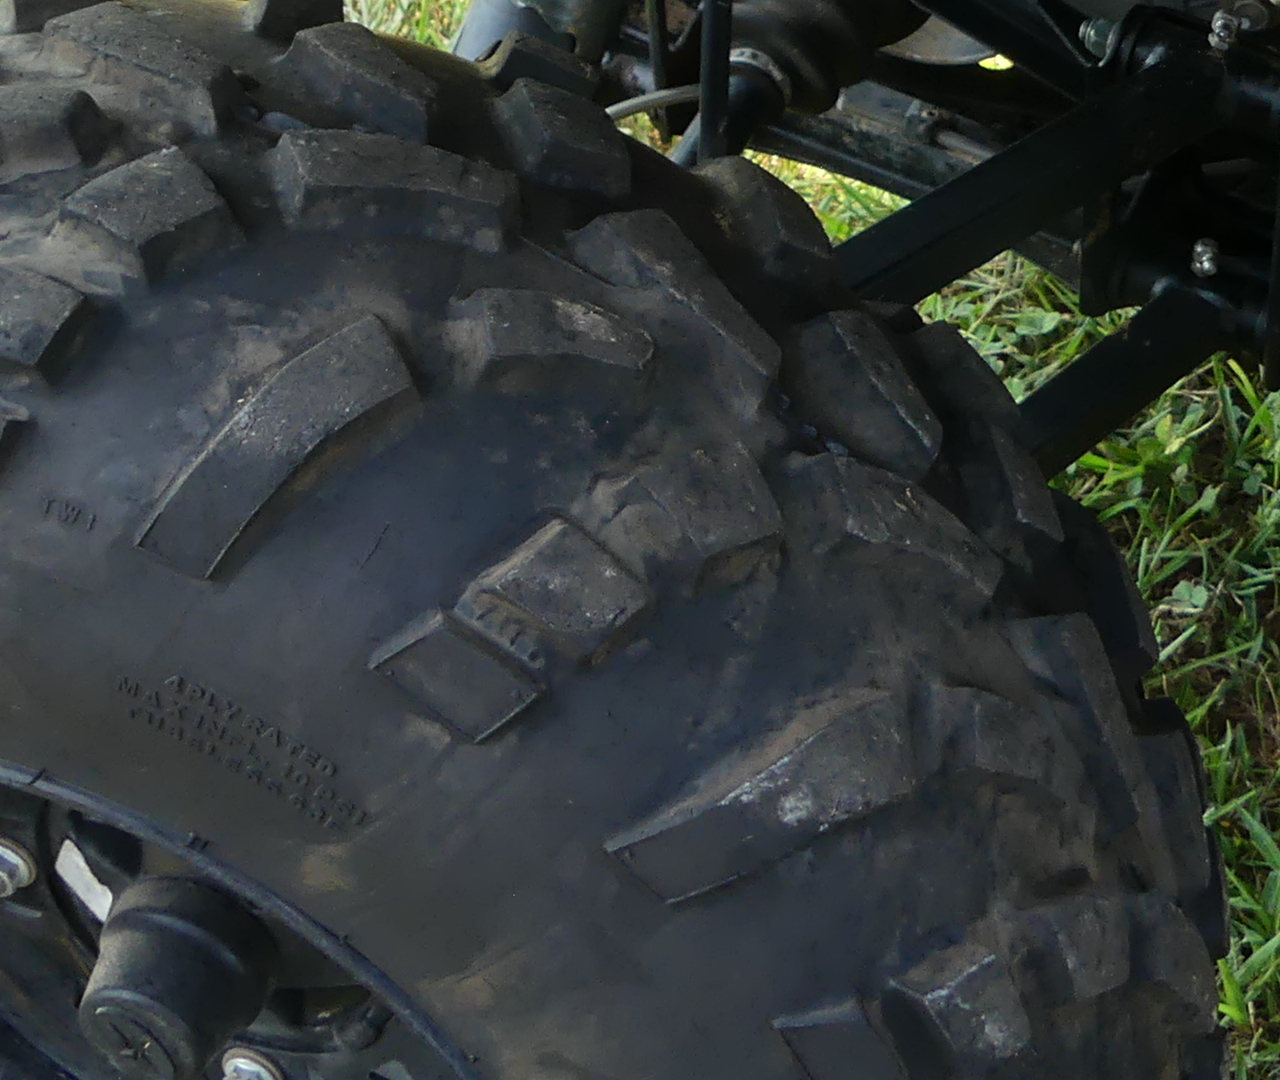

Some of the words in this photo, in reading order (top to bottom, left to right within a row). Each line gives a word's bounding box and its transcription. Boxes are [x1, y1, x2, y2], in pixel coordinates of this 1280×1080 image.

[117, 676, 188, 720] MAX
[313, 782, 368, 827] PSI
[241, 715, 338, 777] RATED
